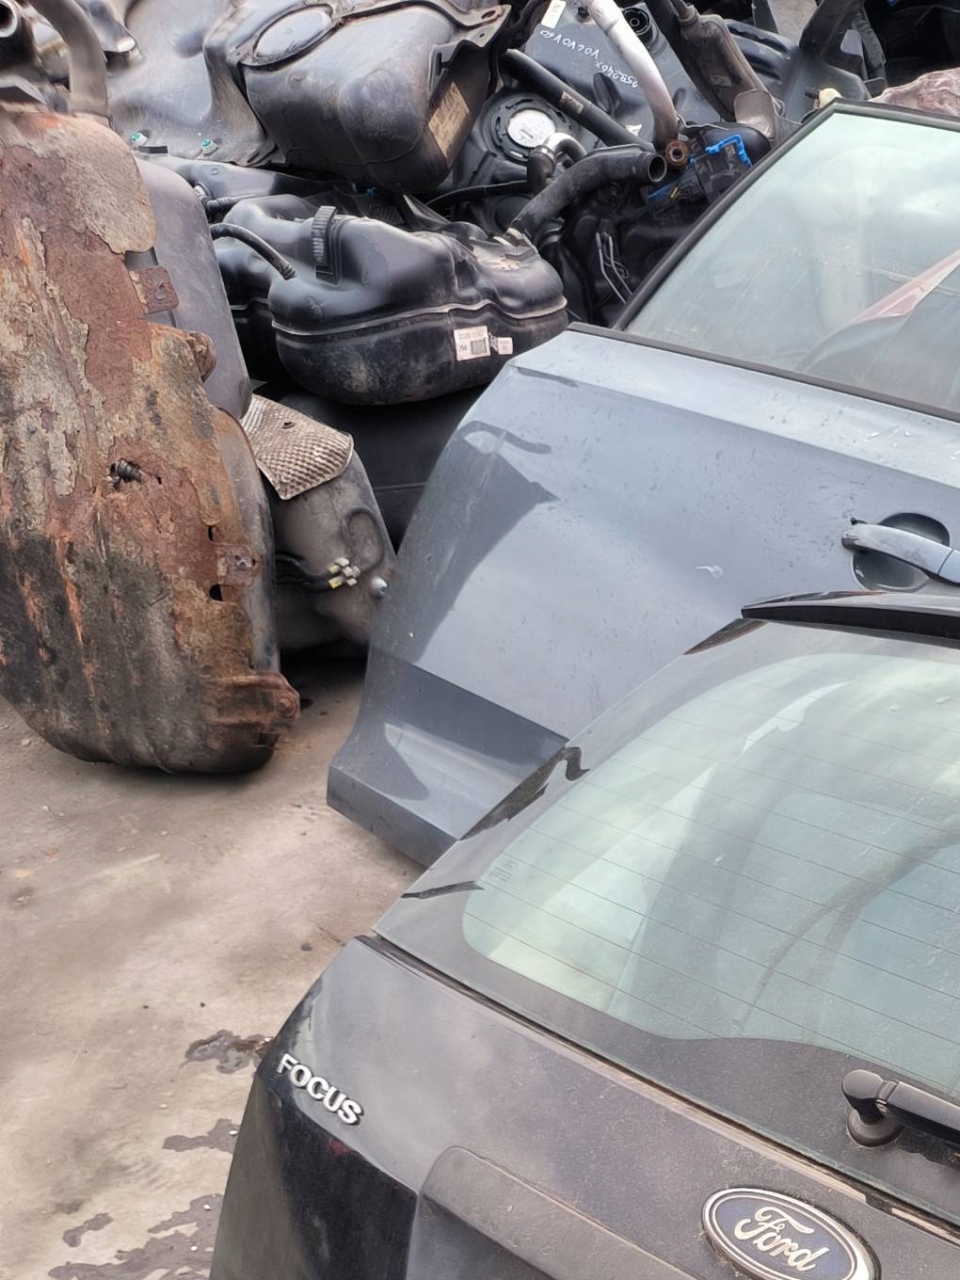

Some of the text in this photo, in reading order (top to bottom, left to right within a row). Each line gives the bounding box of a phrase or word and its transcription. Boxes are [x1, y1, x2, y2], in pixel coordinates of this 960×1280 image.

[562, 37, 600, 60] VOLVO
[276, 1053, 362, 1125] FOCUS
[734, 1206, 830, 1272] Ford
